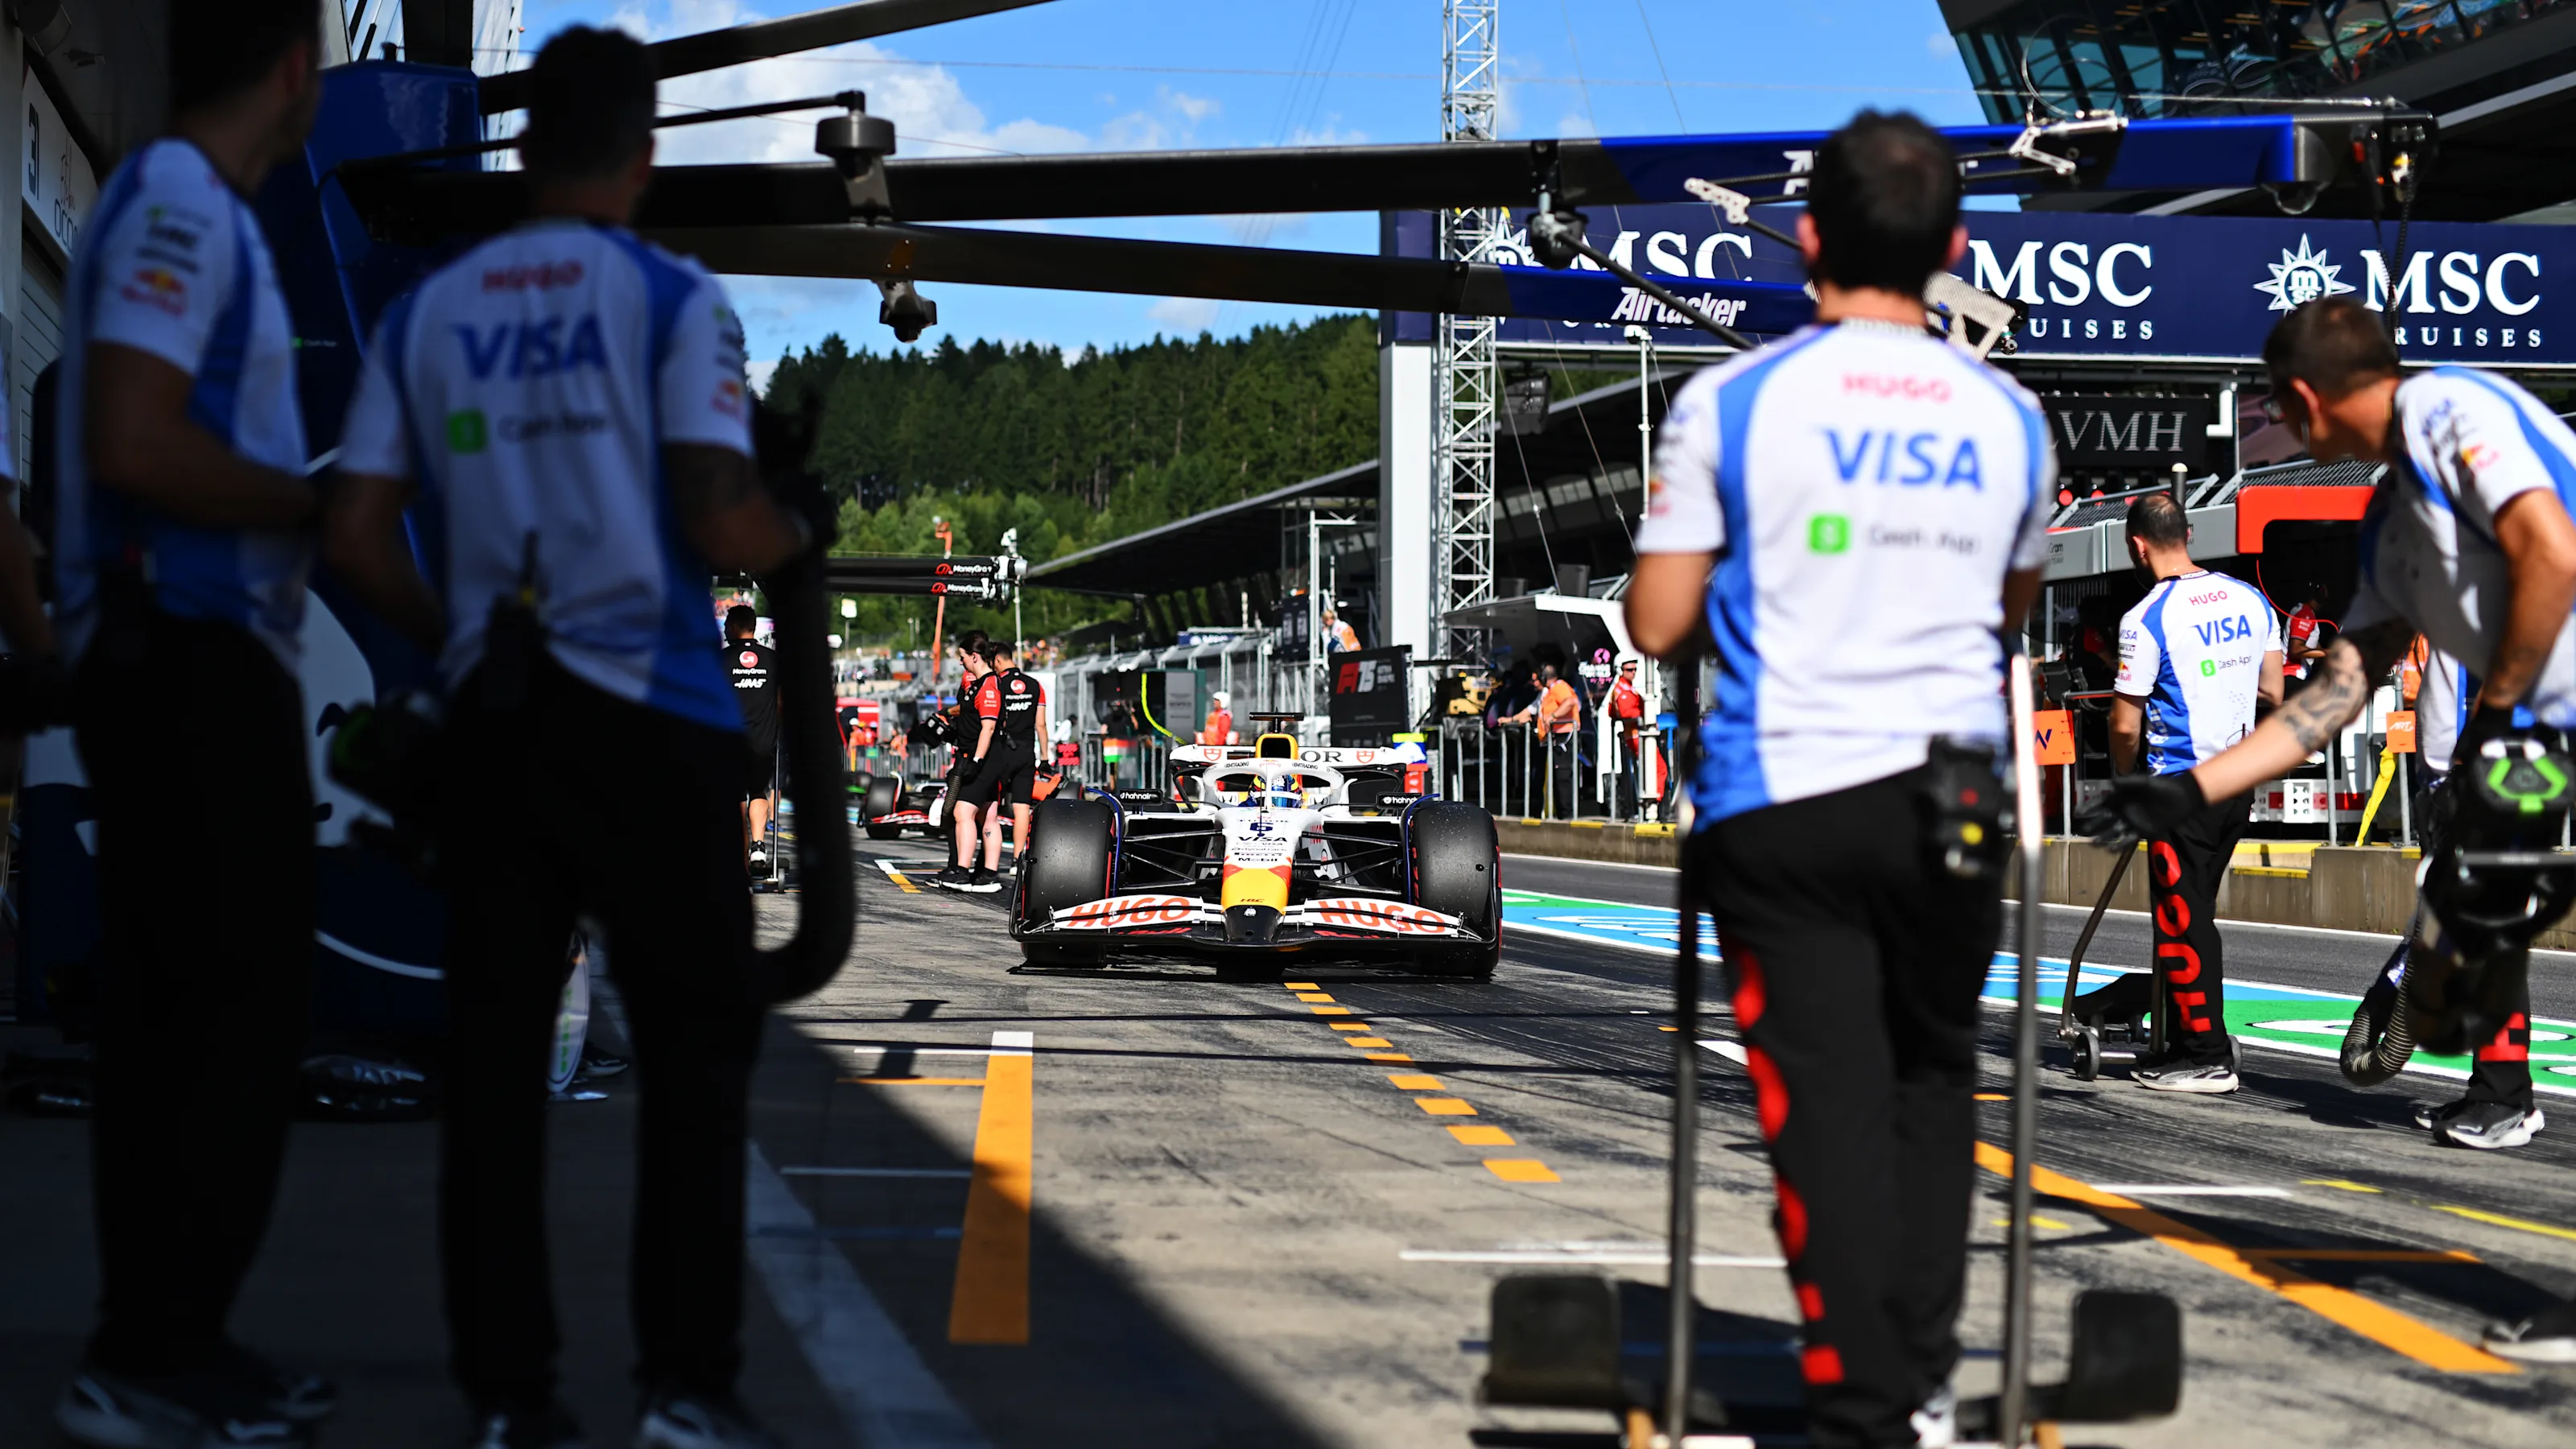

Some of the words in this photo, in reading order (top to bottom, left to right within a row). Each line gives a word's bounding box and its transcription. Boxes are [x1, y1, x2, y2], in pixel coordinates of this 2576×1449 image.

[28, 102, 39, 200] 31
[1968, 239, 2153, 308] MSC
[2359, 250, 2540, 316] MSC
[2029, 319, 2153, 340] UISES
[2394, 327, 2541, 347] RUISES
[456, 314, 610, 379] VISA
[1842, 372, 1954, 403] HUGO
[2054, 409, 2188, 452] VMH
[1819, 427, 1984, 491] VISA
[2189, 590, 2228, 605] HUGO
[2190, 615, 2252, 646] VISA
[2219, 657, 2238, 670] Cash
[1249, 822, 1274, 832] 6
[1067, 897, 1191, 927] HUGO
[1318, 900, 1446, 934] HUGO
